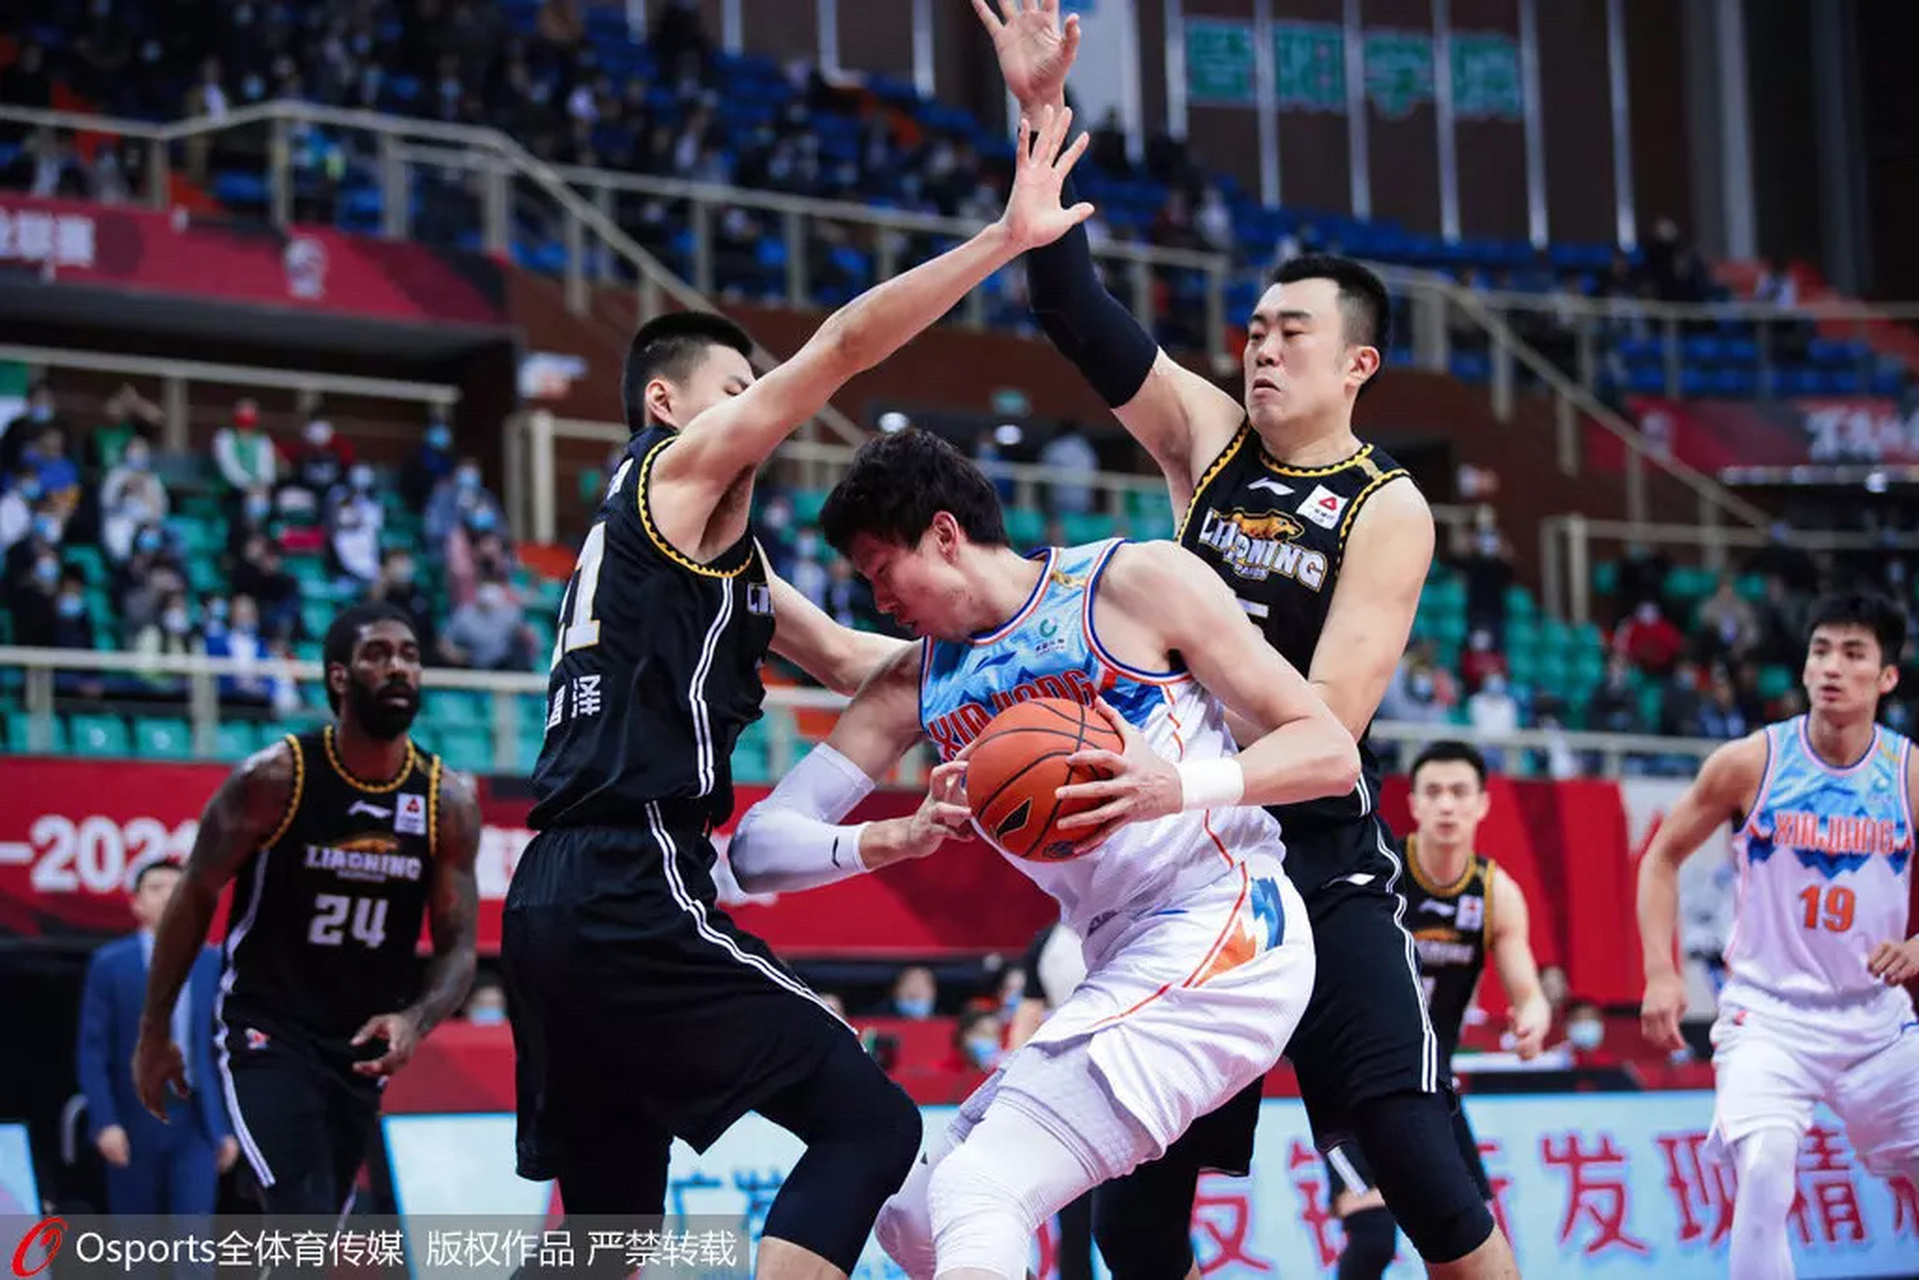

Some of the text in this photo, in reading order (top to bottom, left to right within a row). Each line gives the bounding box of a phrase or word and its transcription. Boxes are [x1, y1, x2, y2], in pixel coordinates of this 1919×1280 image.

[1772, 810, 1895, 856] XINJIANG
[304, 844, 423, 881] LIAONING
[308, 893, 389, 949] 24
[1799, 884, 1856, 933] 19
